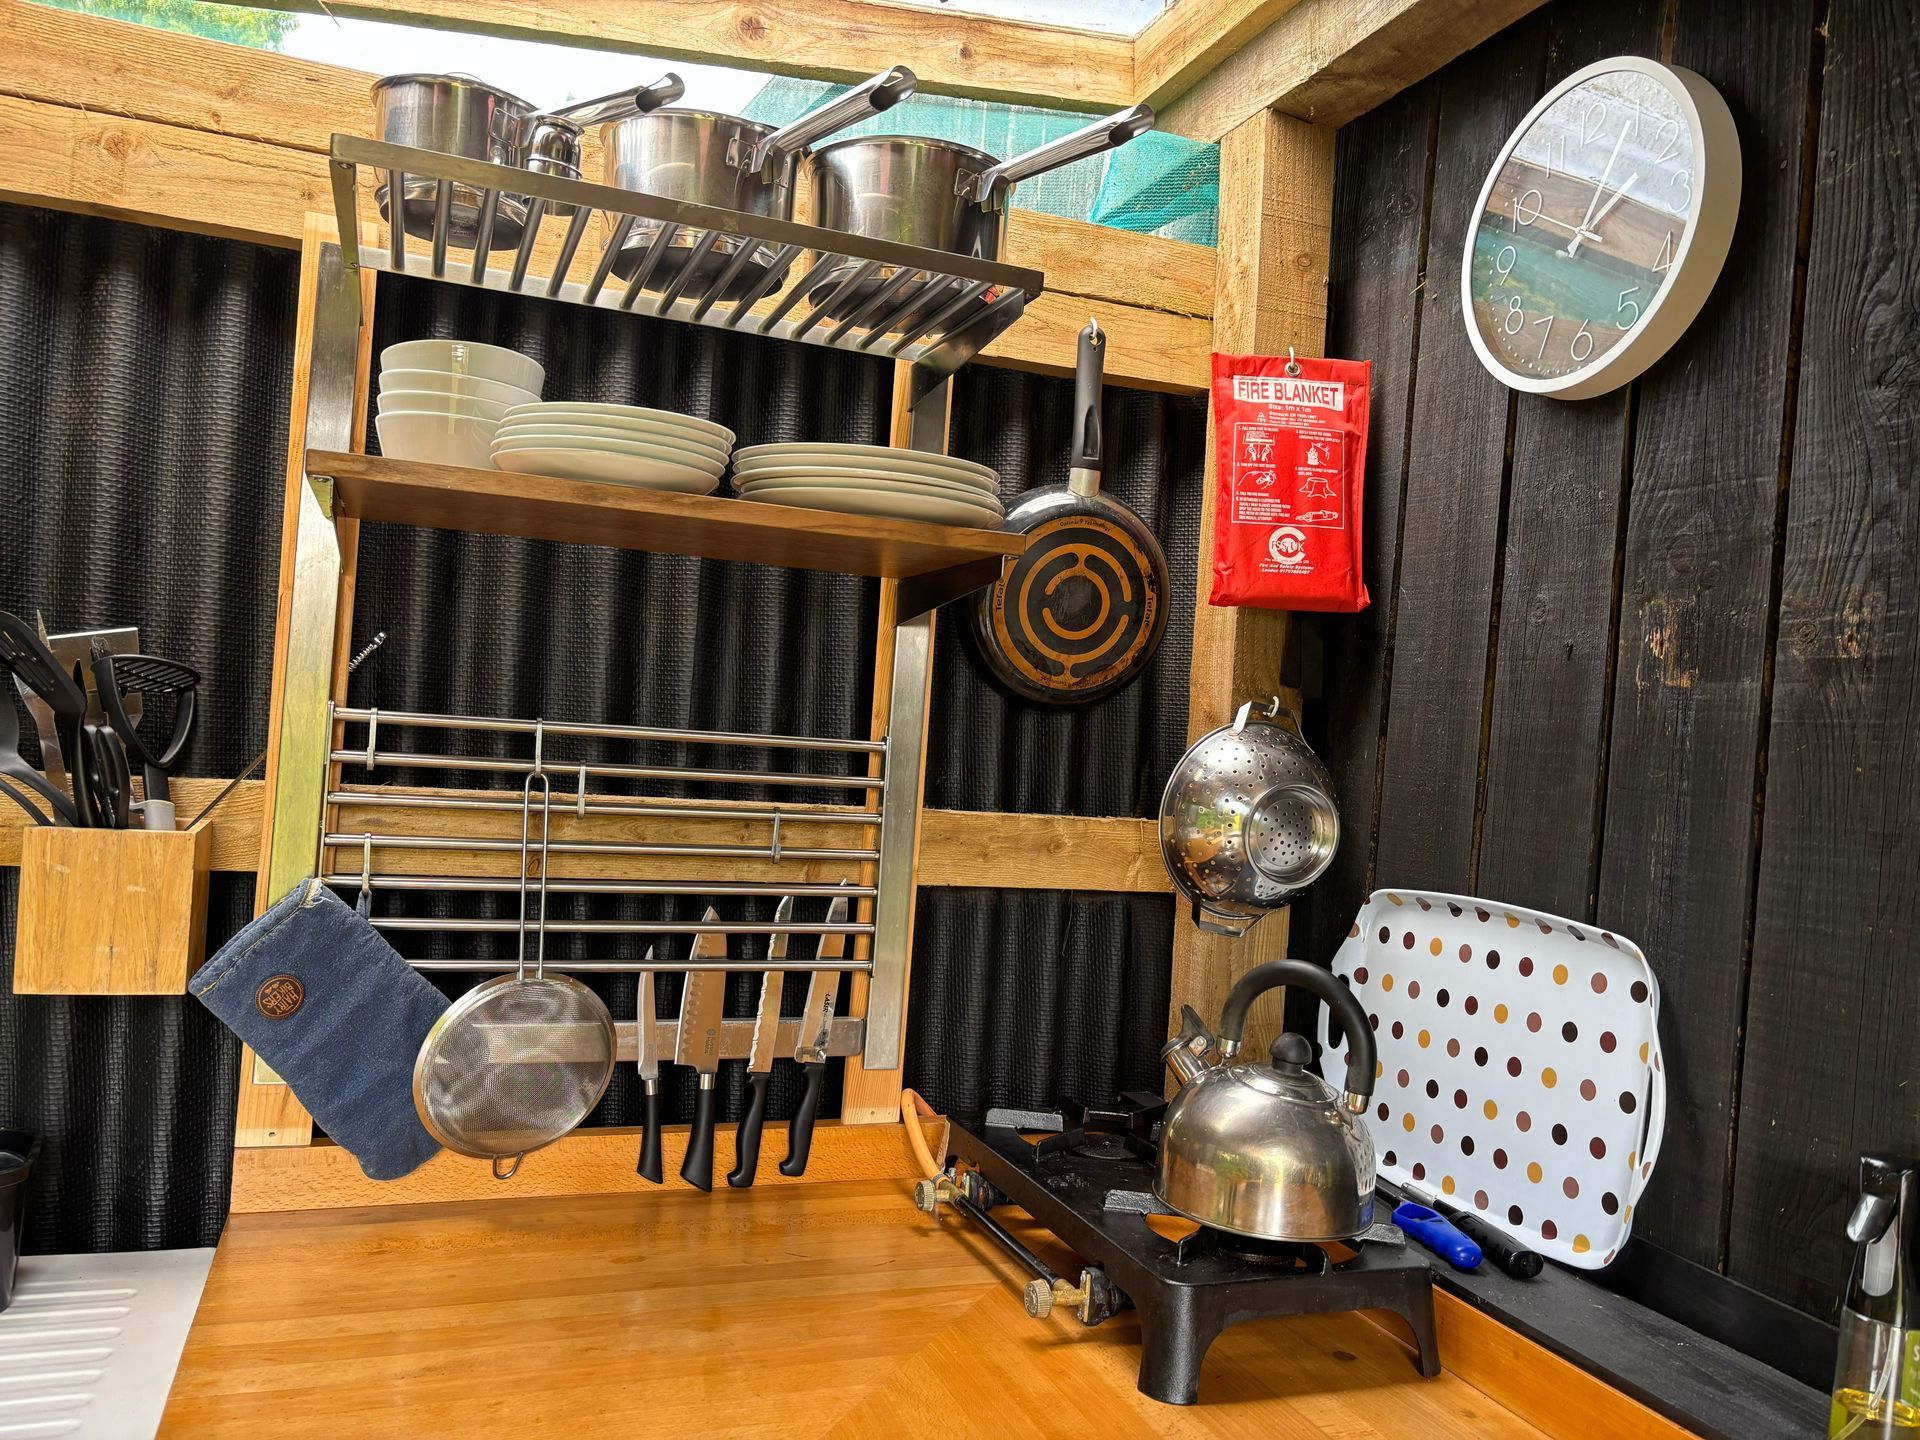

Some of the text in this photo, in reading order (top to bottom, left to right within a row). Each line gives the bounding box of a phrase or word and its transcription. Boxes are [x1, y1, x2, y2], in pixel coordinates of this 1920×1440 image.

[1580, 102, 1607, 147] 12
[1630, 99, 1640, 136] 1
[1546, 135, 1566, 179] 11
[1655, 120, 1679, 164] 2
[1513, 189, 1542, 233] 10
[1667, 170, 1692, 213] 3
[1496, 246, 1516, 286] 9
[1652, 231, 1673, 272] 4
[1505, 296, 1524, 334] 8
[1616, 287, 1639, 330] 5
[1533, 316, 1553, 359] 7
[1570, 319, 1593, 361] 6
[1238, 381, 1338, 407] FIRE BLANKET
[996, 583, 1005, 611] Tefal
[1145, 595, 1153, 624] Tefal
[262, 982, 294, 1008] BIKERS
[273, 990, 299, 1014] HAIRY
